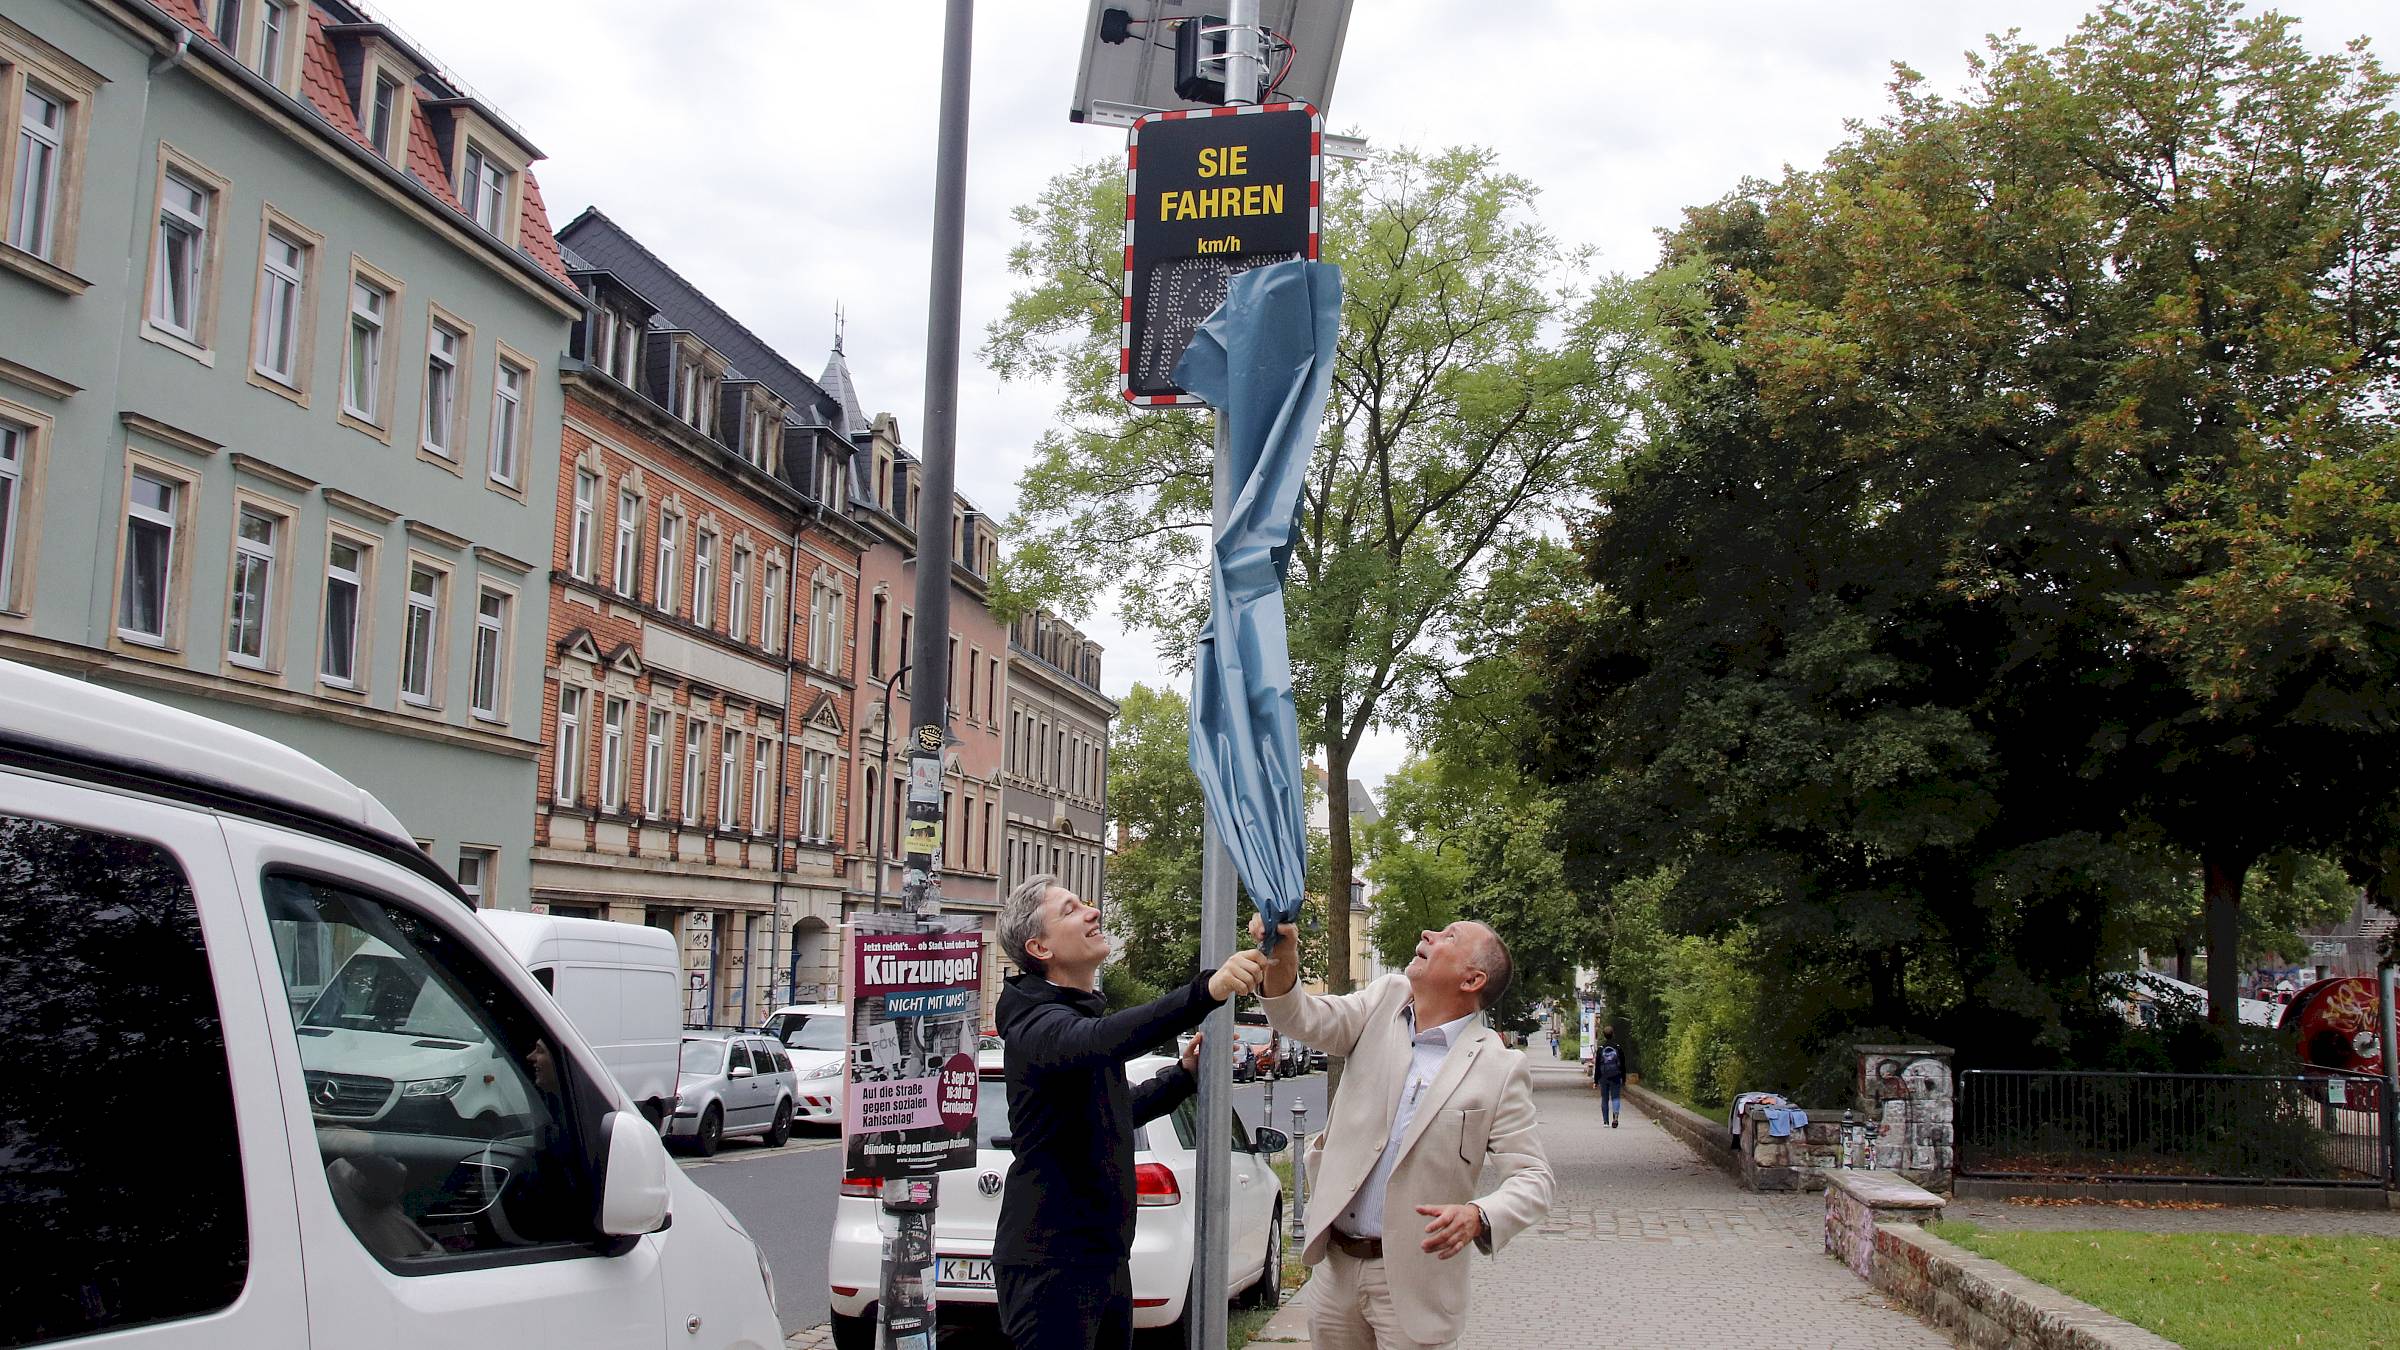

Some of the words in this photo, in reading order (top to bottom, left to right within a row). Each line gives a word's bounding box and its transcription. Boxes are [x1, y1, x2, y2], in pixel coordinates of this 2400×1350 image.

[1198, 146, 1248, 178] SIE
[1160, 184, 1285, 222] FAHREN
[1197, 236, 1241, 253] km/h
[863, 942, 881, 952] Jetzt
[918, 942, 928, 951] ob
[863, 951, 978, 985] Kürzungen?
[888, 997, 925, 1012] NICHT
[927, 995, 944, 1011] MIT
[946, 991, 965, 1008] UNS!
[943, 1070, 950, 1085] 3.
[951, 1071, 966, 1087] Sept
[862, 1087, 877, 1100] Auf
[880, 1085, 893, 1098] die
[895, 1083, 923, 1097] Straße
[962, 1087, 972, 1100] Uhr
[862, 1101, 891, 1115] gegen
[893, 1098, 928, 1111] sozialen
[862, 1112, 914, 1127] Kahlschlag!
[863, 1143, 896, 1155] Bündnis
[896, 1143, 921, 1155] gegen
[944, 1261, 956, 1280] K
[968, 1261, 993, 1281] LK
